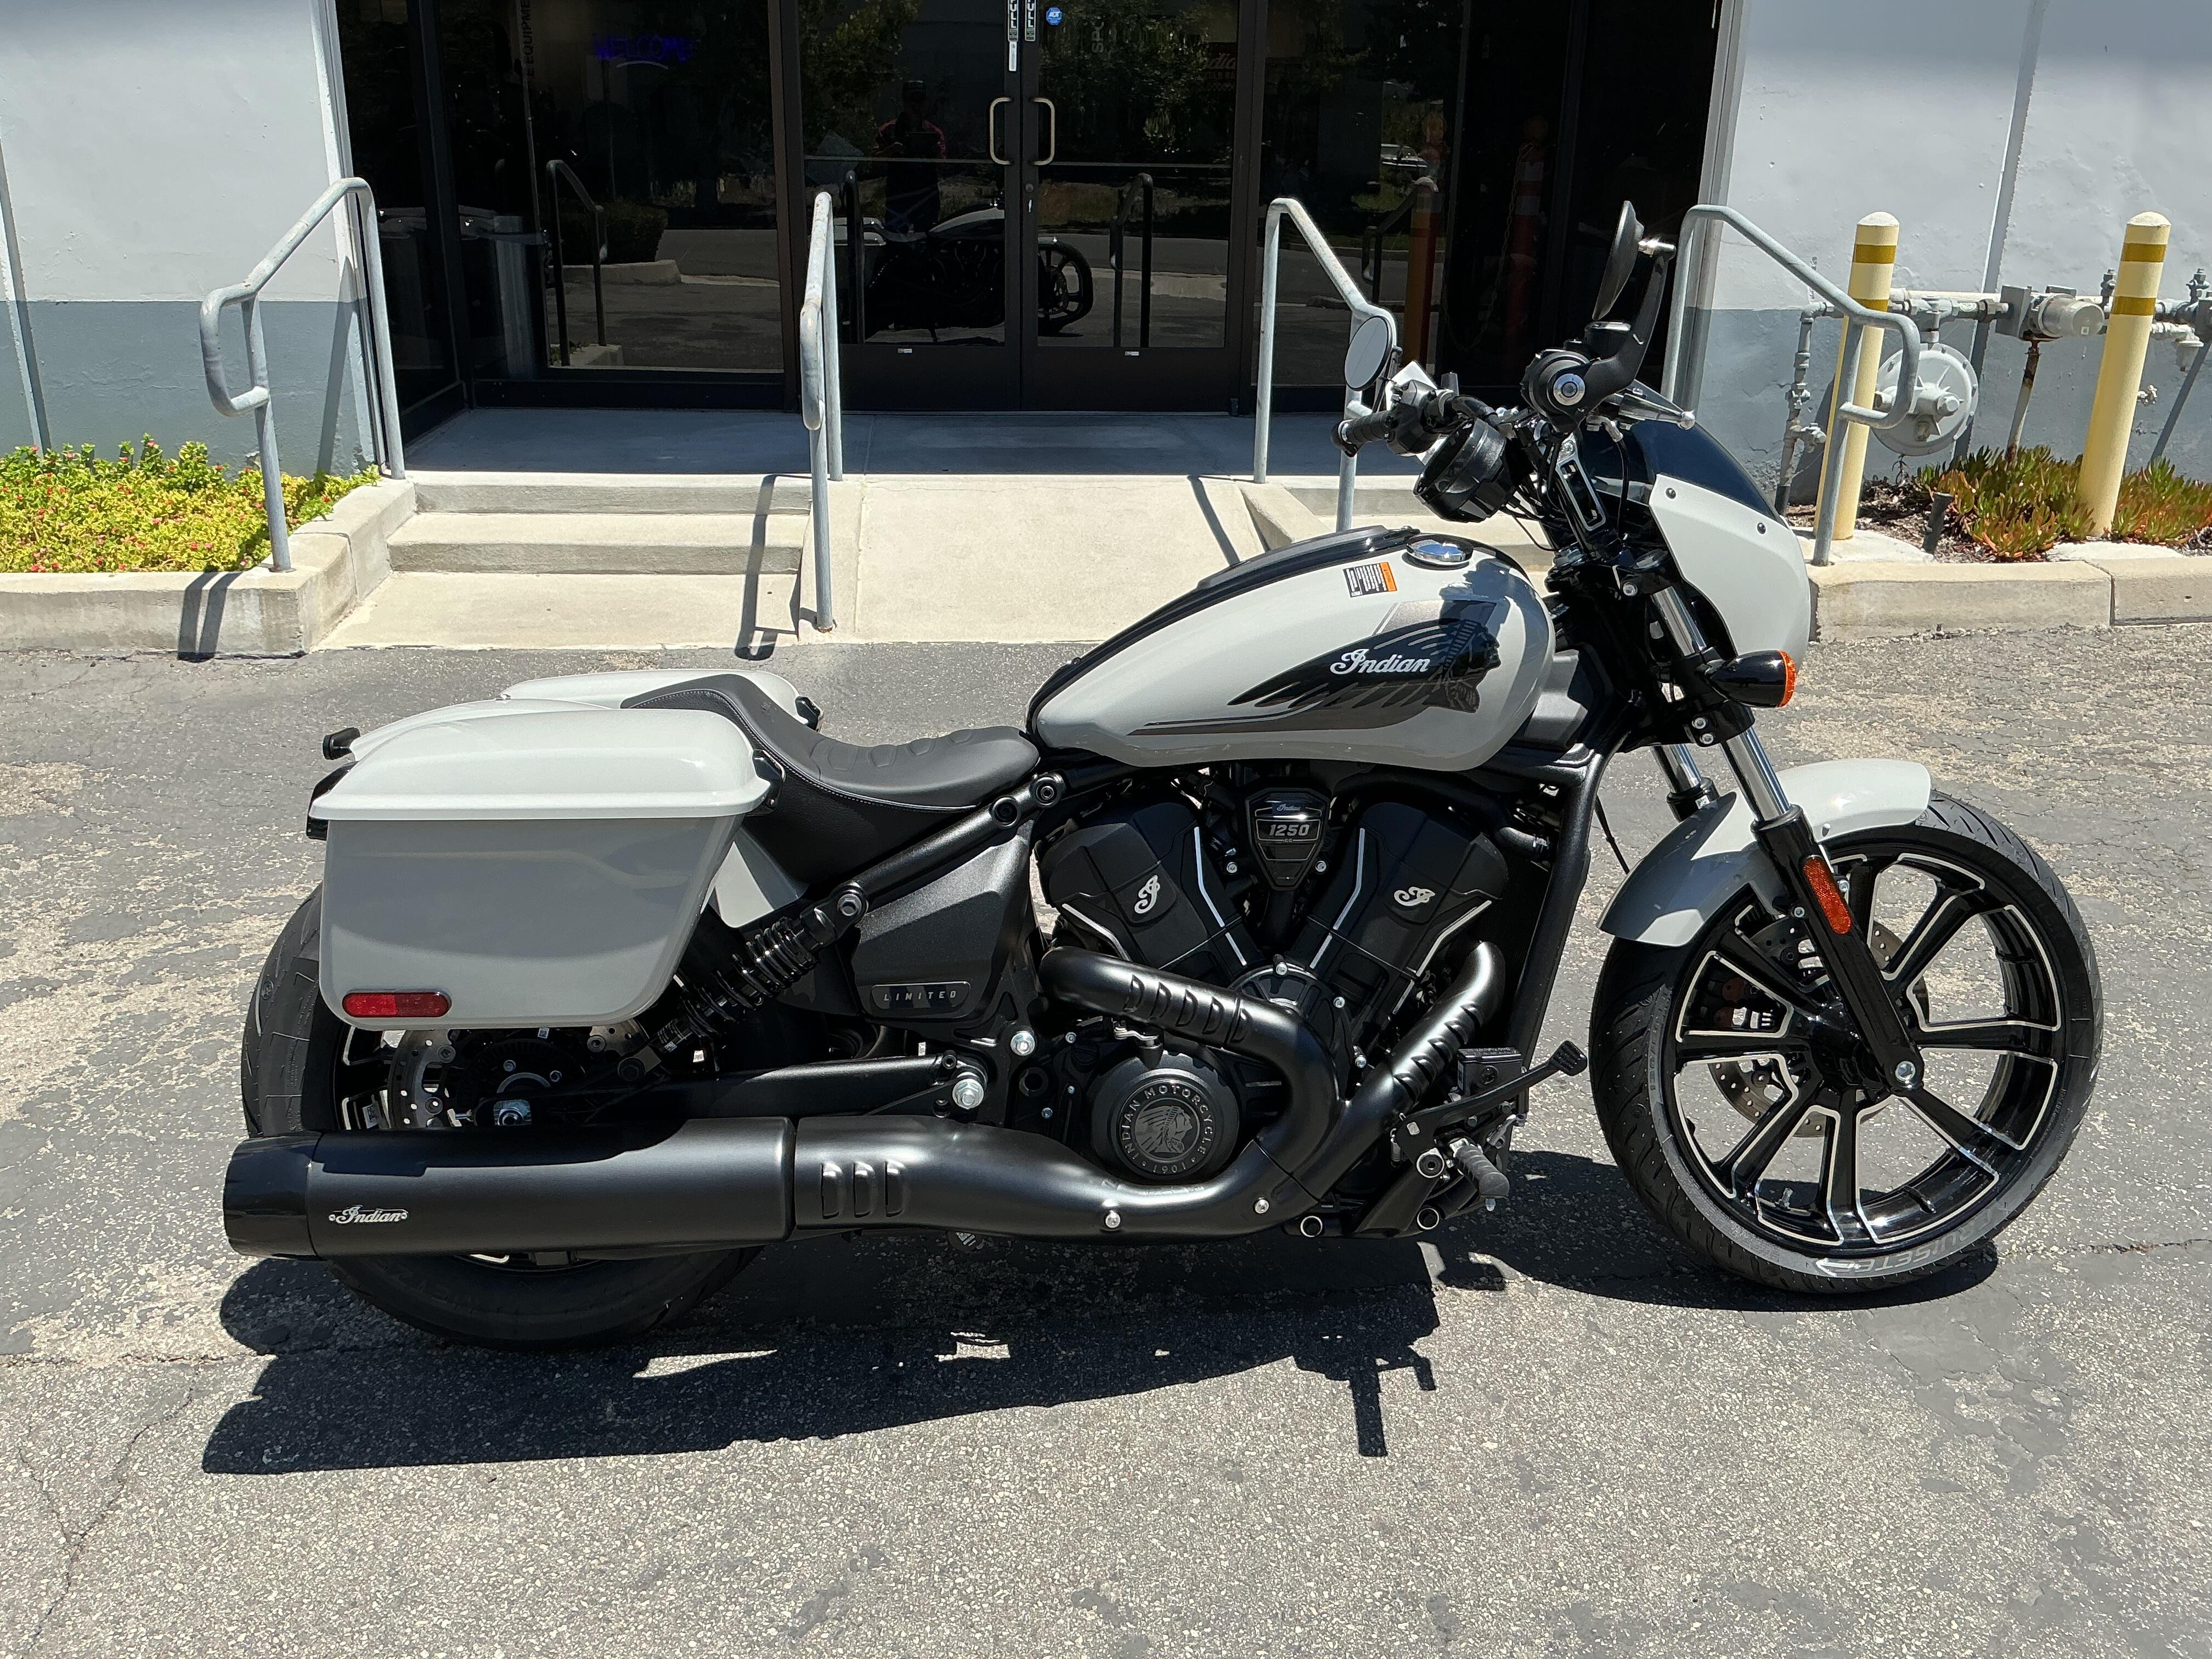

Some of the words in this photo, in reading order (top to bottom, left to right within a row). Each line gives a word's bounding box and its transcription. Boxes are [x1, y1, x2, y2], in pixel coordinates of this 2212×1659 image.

[1330, 648, 1431, 675] Indian
[1276, 803, 1301, 811] Indian
[1269, 824, 1310, 836] 1250
[884, 990, 956, 1001] LIMITED
[1121, 1099, 1141, 1160] INDIAN
[1144, 1085, 1214, 1155] MOTORCYCLE
[1153, 1161, 1187, 1174] 1901
[335, 1206, 402, 1224] Indian
